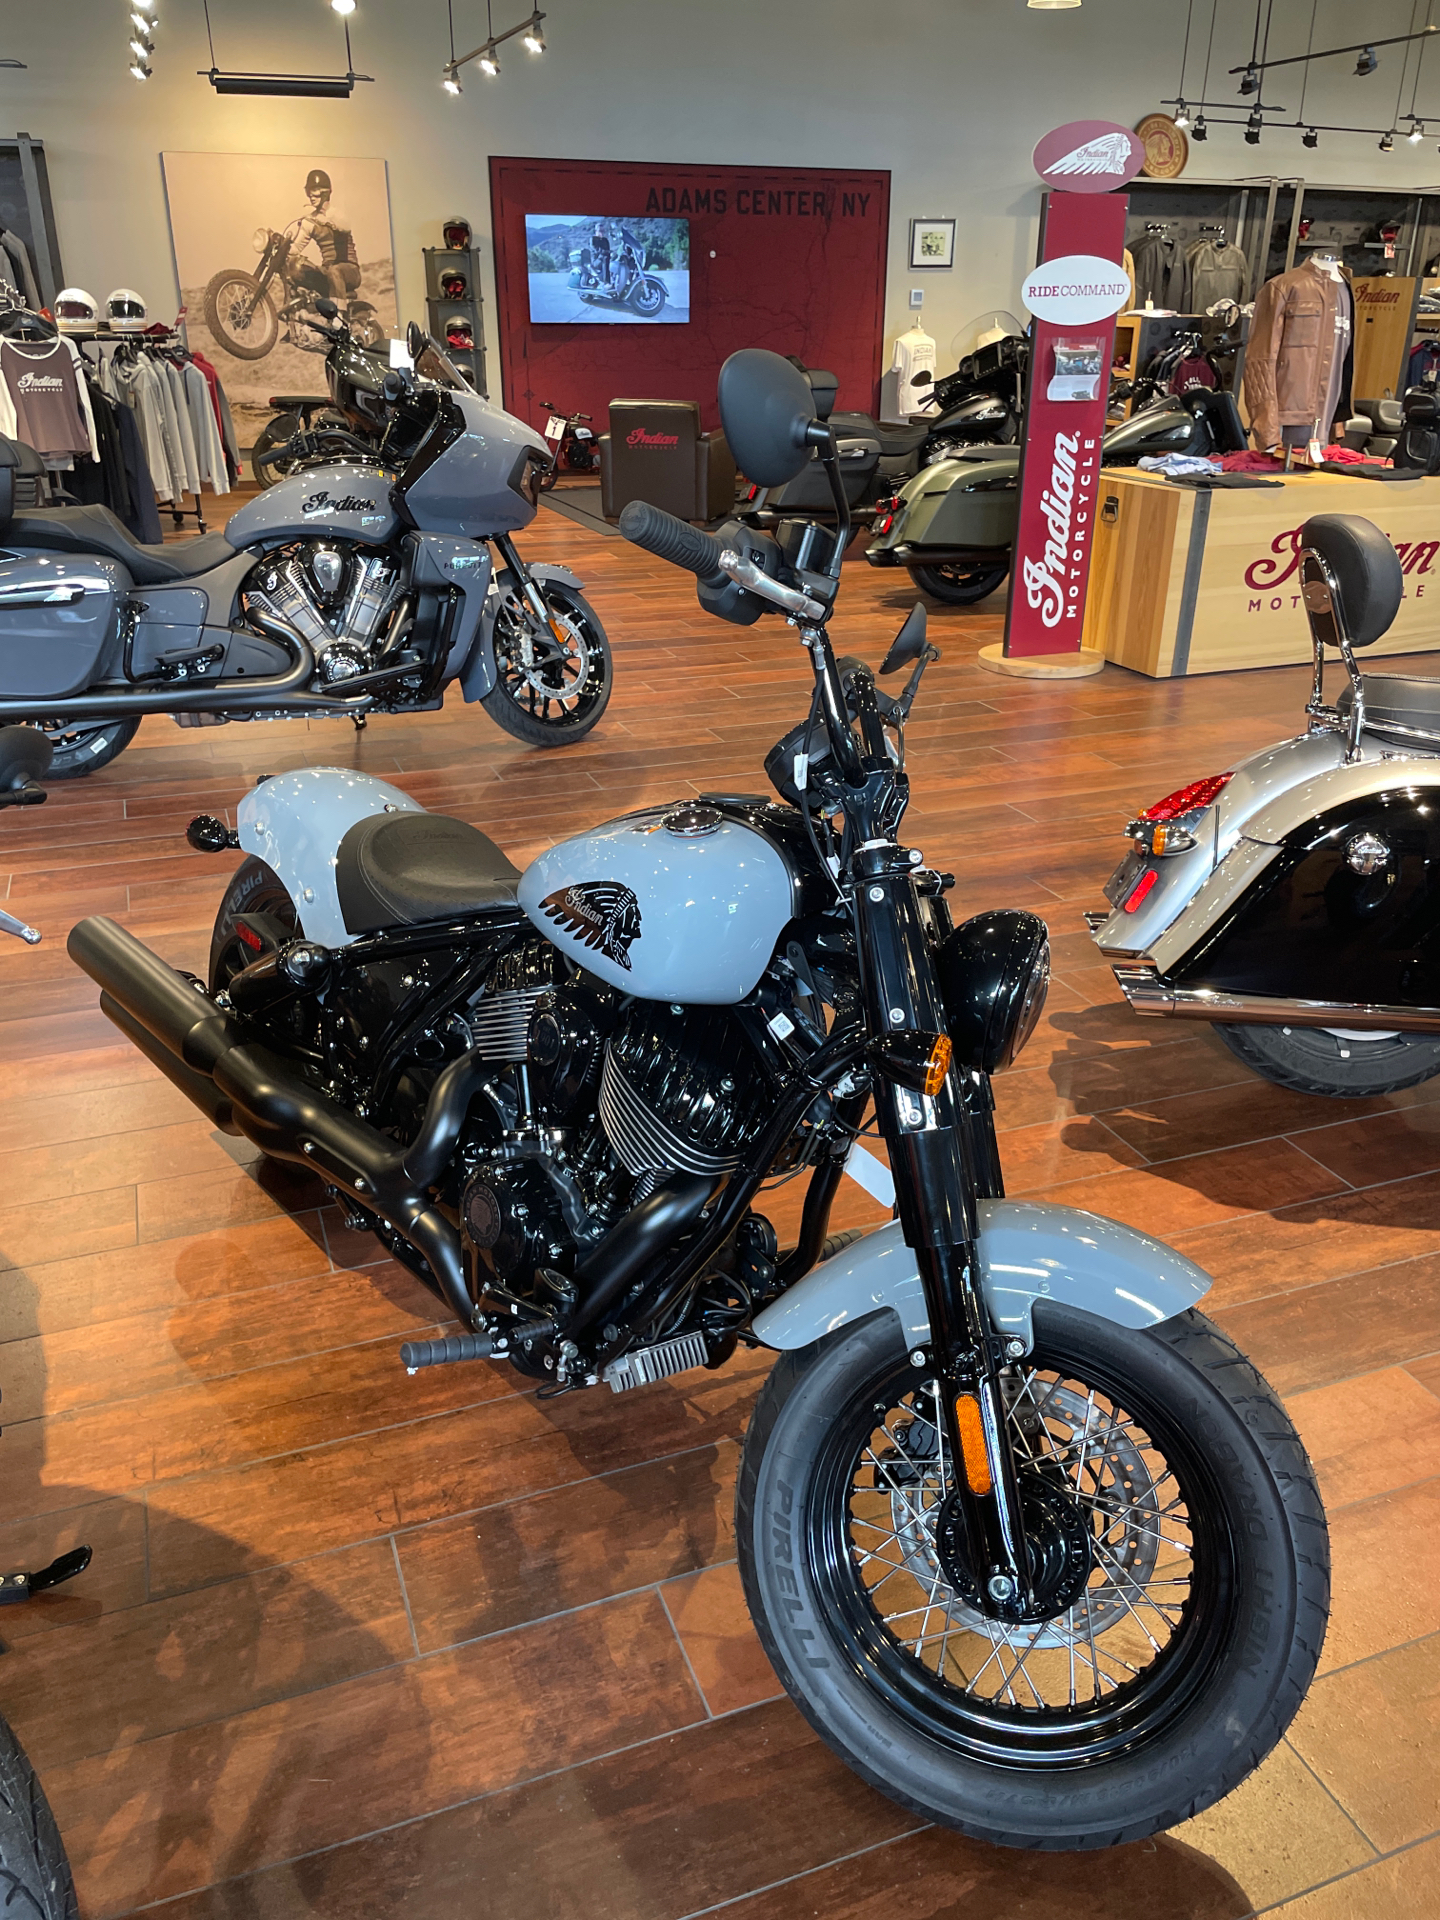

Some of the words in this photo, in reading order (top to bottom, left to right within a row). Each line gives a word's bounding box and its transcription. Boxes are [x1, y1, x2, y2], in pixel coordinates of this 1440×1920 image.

[646, 187, 727, 214] ADAMS
[842, 192, 871, 217] NY
[1028, 286, 1060, 298] RIDE
[17, 372, 63, 388] Indian
[626, 428, 679, 444] Indian
[302, 491, 376, 513] Indian
[1023, 431, 1080, 628] Indian
[1066, 439, 1095, 617] MOTORCYCLE
[564, 887, 604, 926] Indian
[772, 1479, 831, 1669] PIRELLI
[1240, 1554, 1274, 1679] NIGHT
